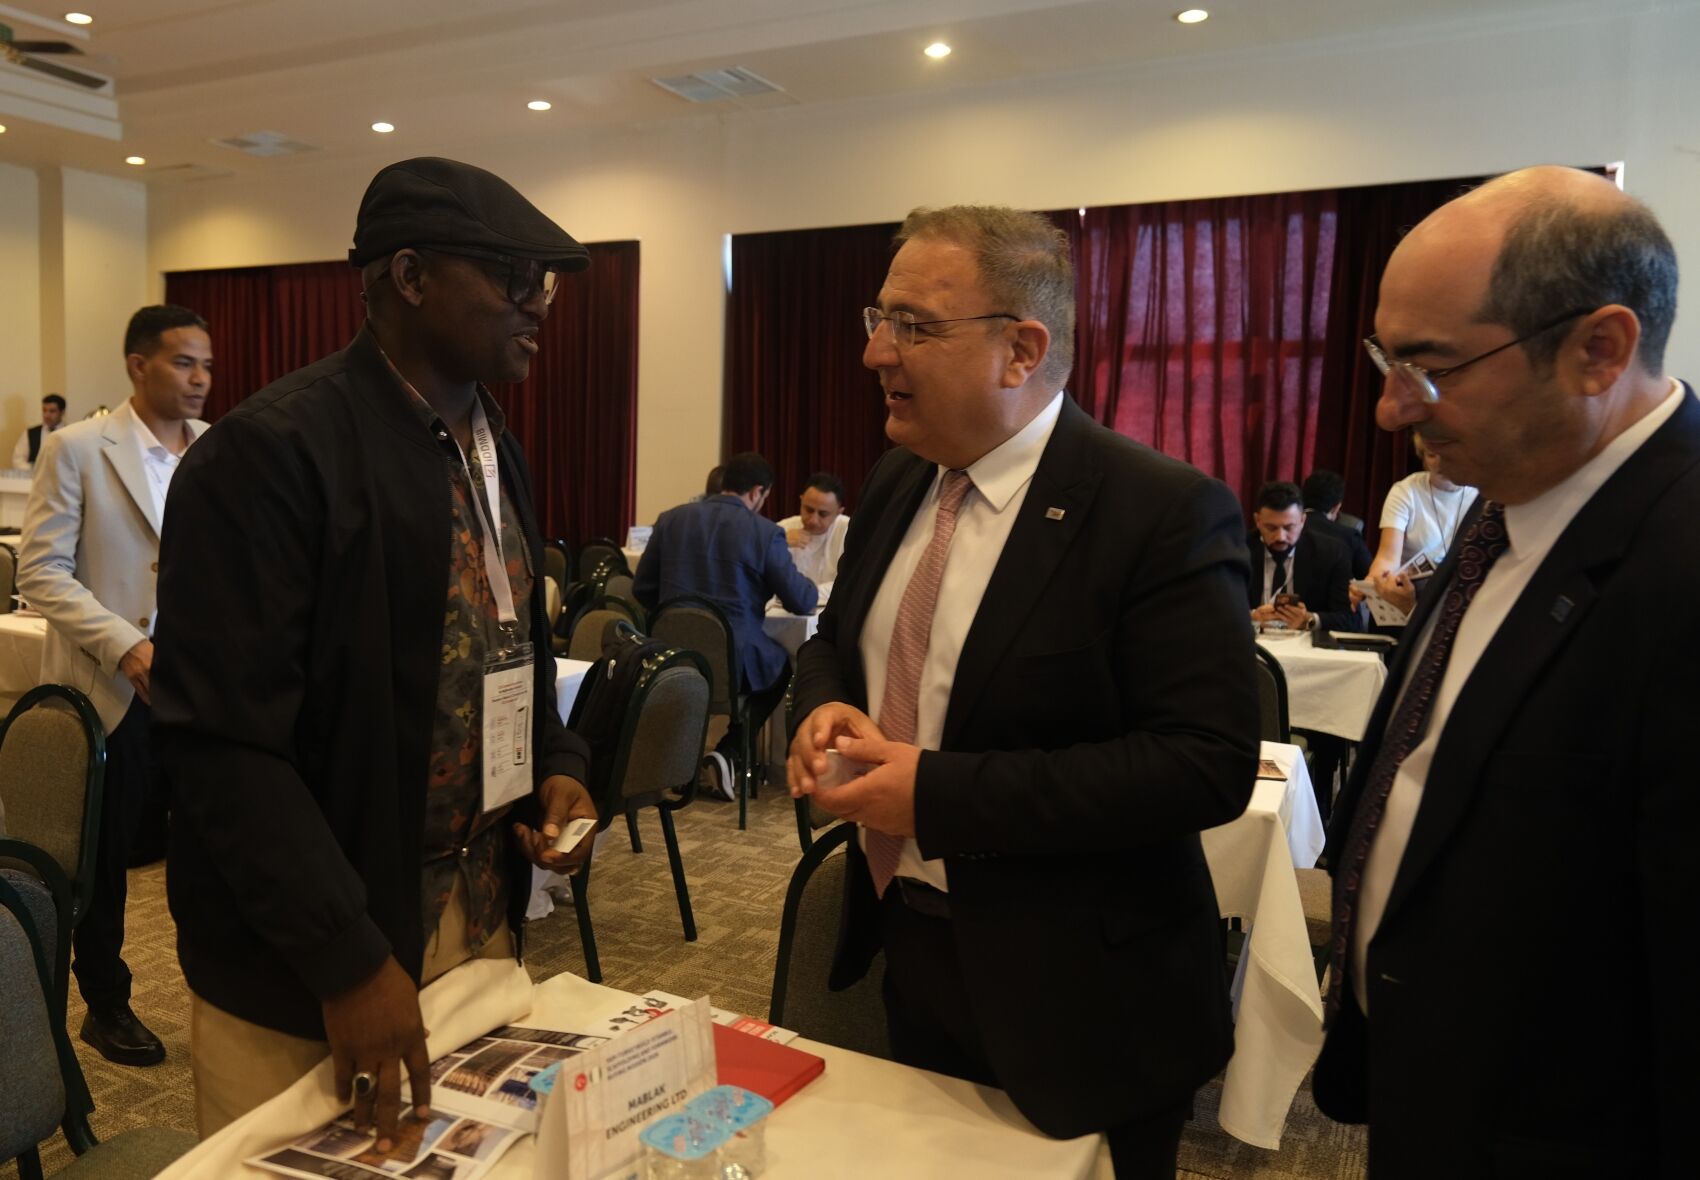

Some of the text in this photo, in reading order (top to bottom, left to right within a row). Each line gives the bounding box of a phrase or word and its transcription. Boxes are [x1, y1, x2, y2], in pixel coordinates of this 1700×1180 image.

[606, 1088, 688, 1140] ENGINEERING LTD
[627, 1083, 666, 1112] MABLAK
